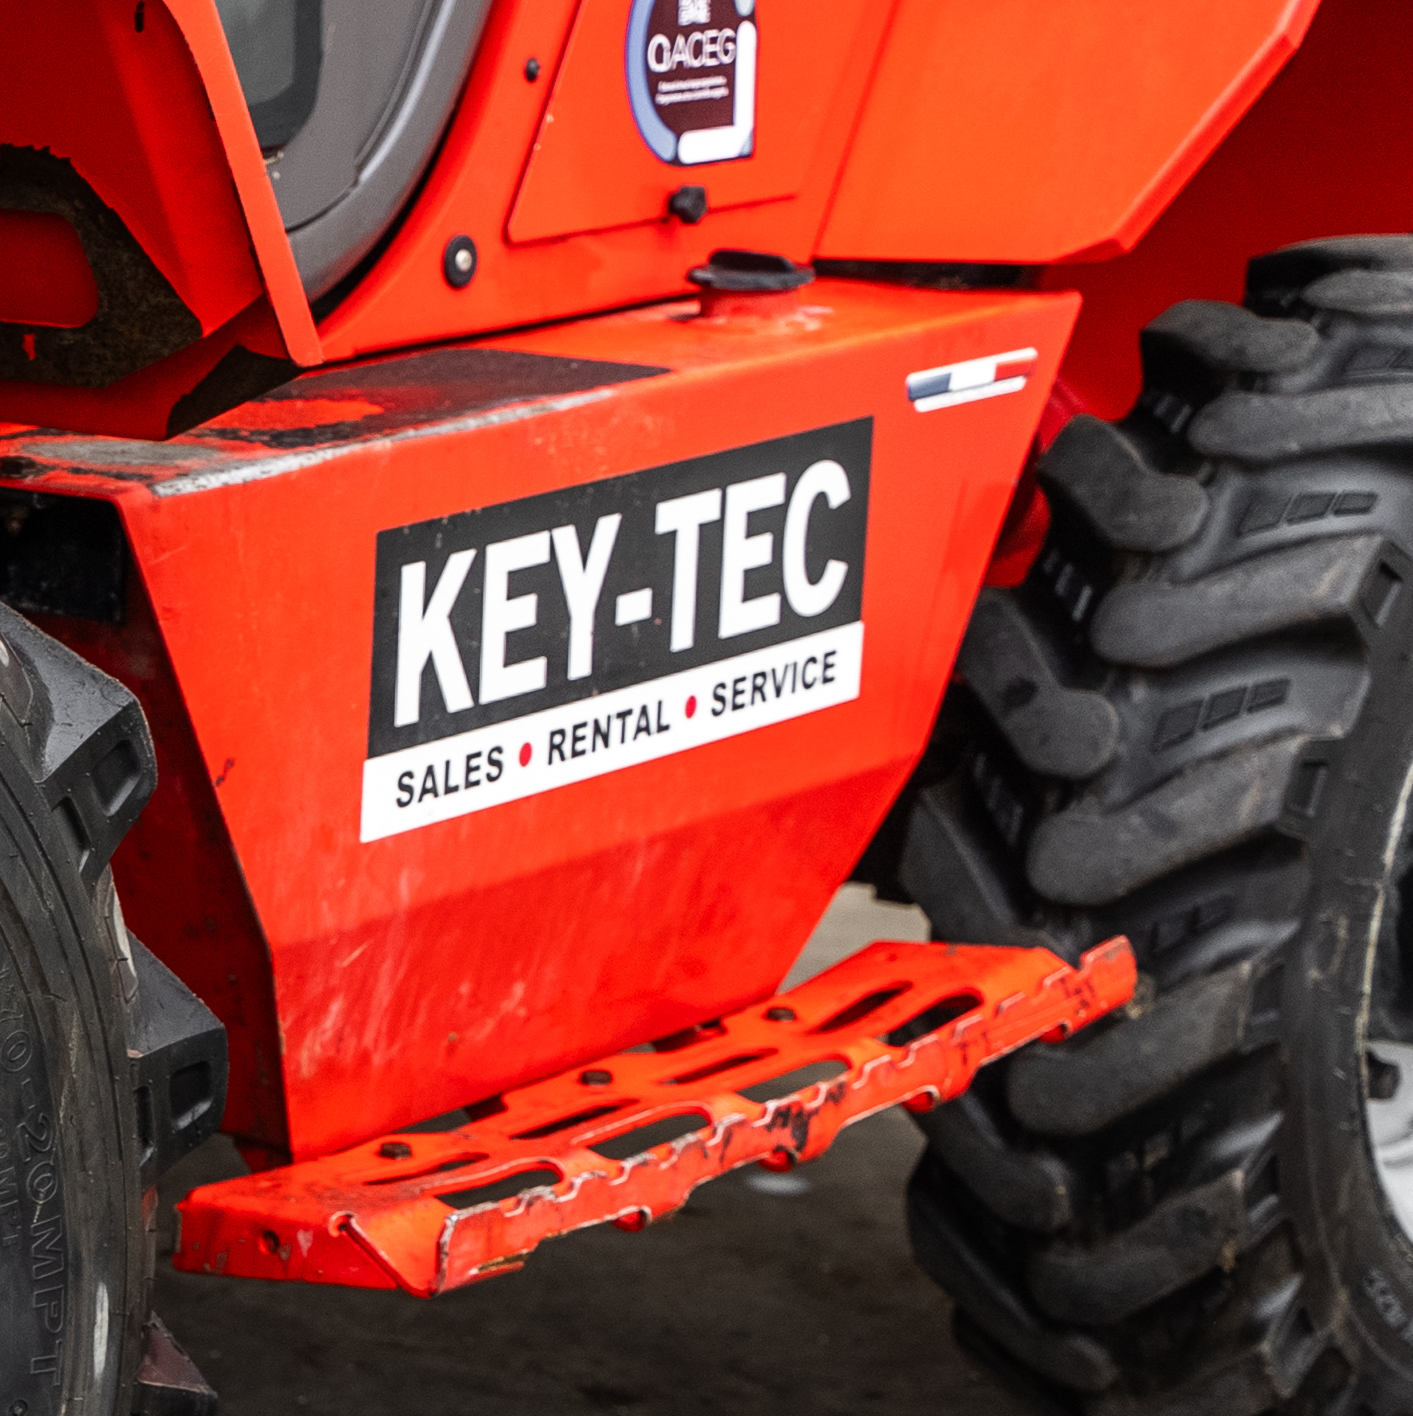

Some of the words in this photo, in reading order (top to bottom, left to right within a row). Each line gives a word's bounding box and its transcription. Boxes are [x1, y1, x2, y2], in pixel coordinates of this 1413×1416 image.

[394, 458, 851, 729] KEY-TEC
[395, 744, 505, 809] SALES
[547, 699, 672, 767] RENTAL
[709, 648, 838, 718] SERVICE
